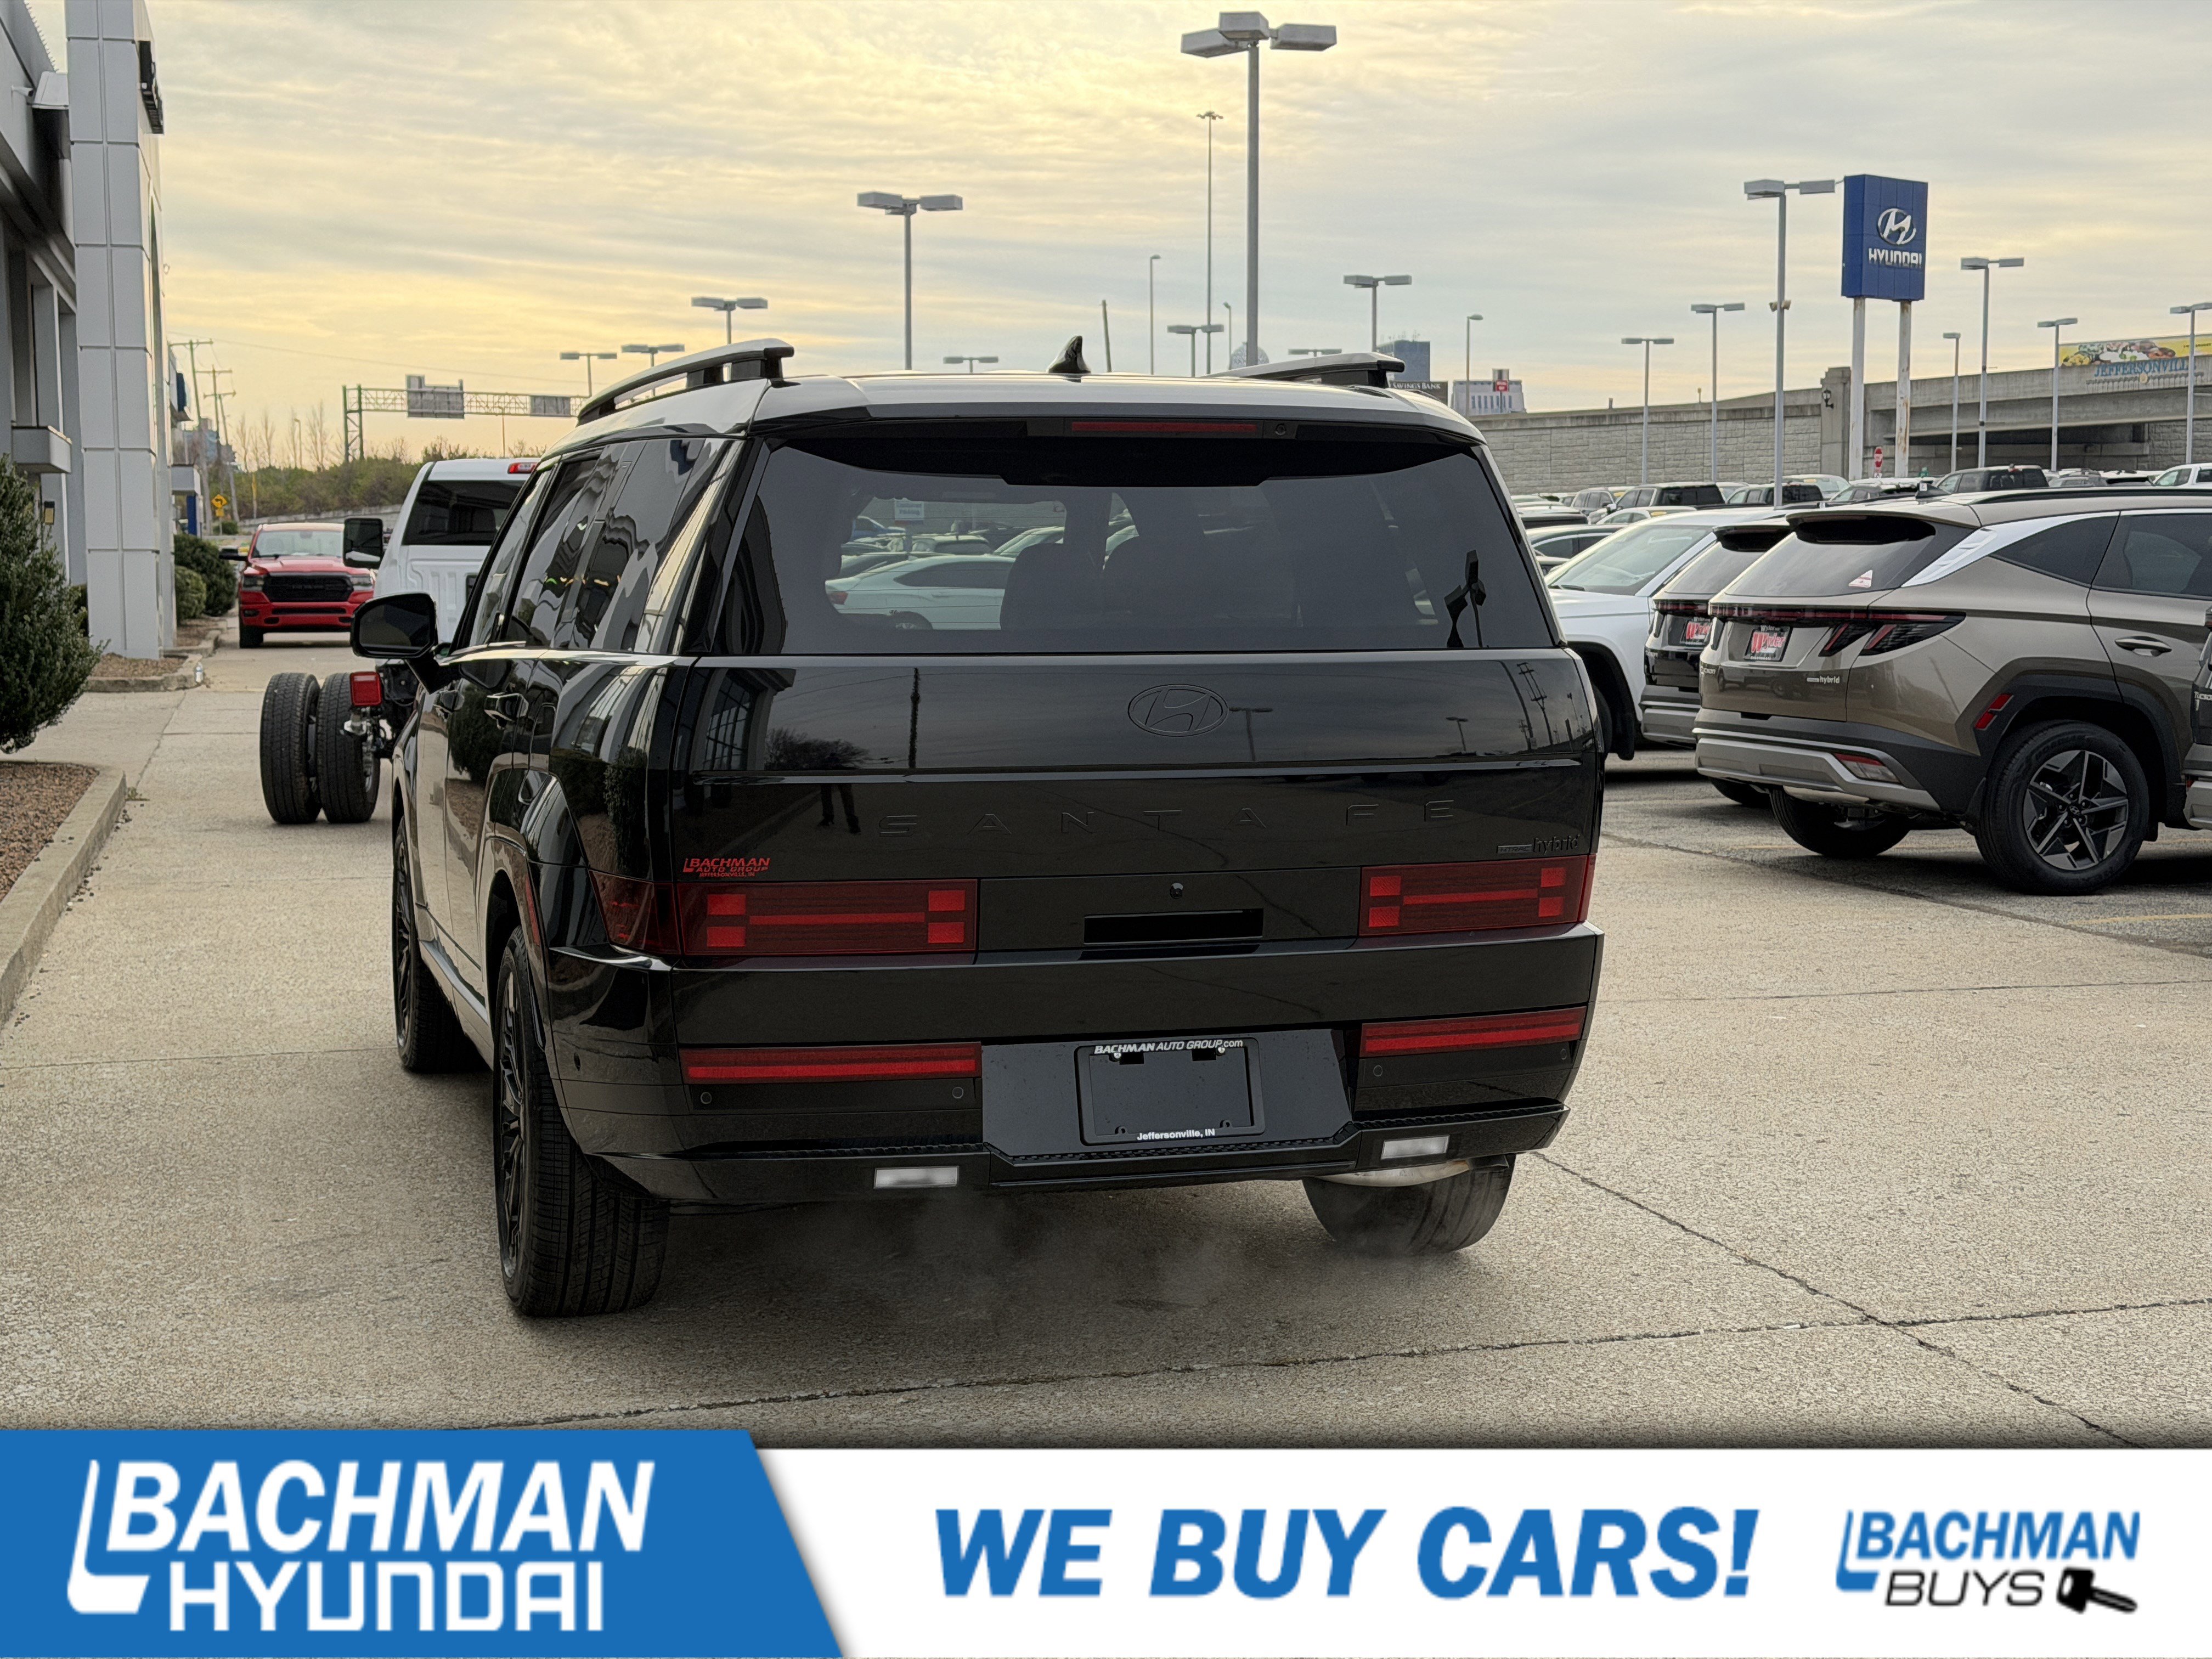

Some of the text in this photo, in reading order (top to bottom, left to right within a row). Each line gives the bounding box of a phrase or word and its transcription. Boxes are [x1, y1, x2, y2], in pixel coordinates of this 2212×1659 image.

[1868, 247, 1922, 268] HYUNDAI
[2094, 358, 2197, 377] JEFFERSONVILL
[1751, 631, 1786, 653] Wyler
[1819, 675, 1840, 685] hybrid
[879, 799, 1454, 837] SANTA FE
[1533, 834, 1581, 856] hybrid
[690, 857, 771, 867] BACHMAN
[1094, 1039, 1244, 1054] BACHMAN AUTO GROUP.com
[1137, 1128, 1216, 1141] Jeffersonville, IN
